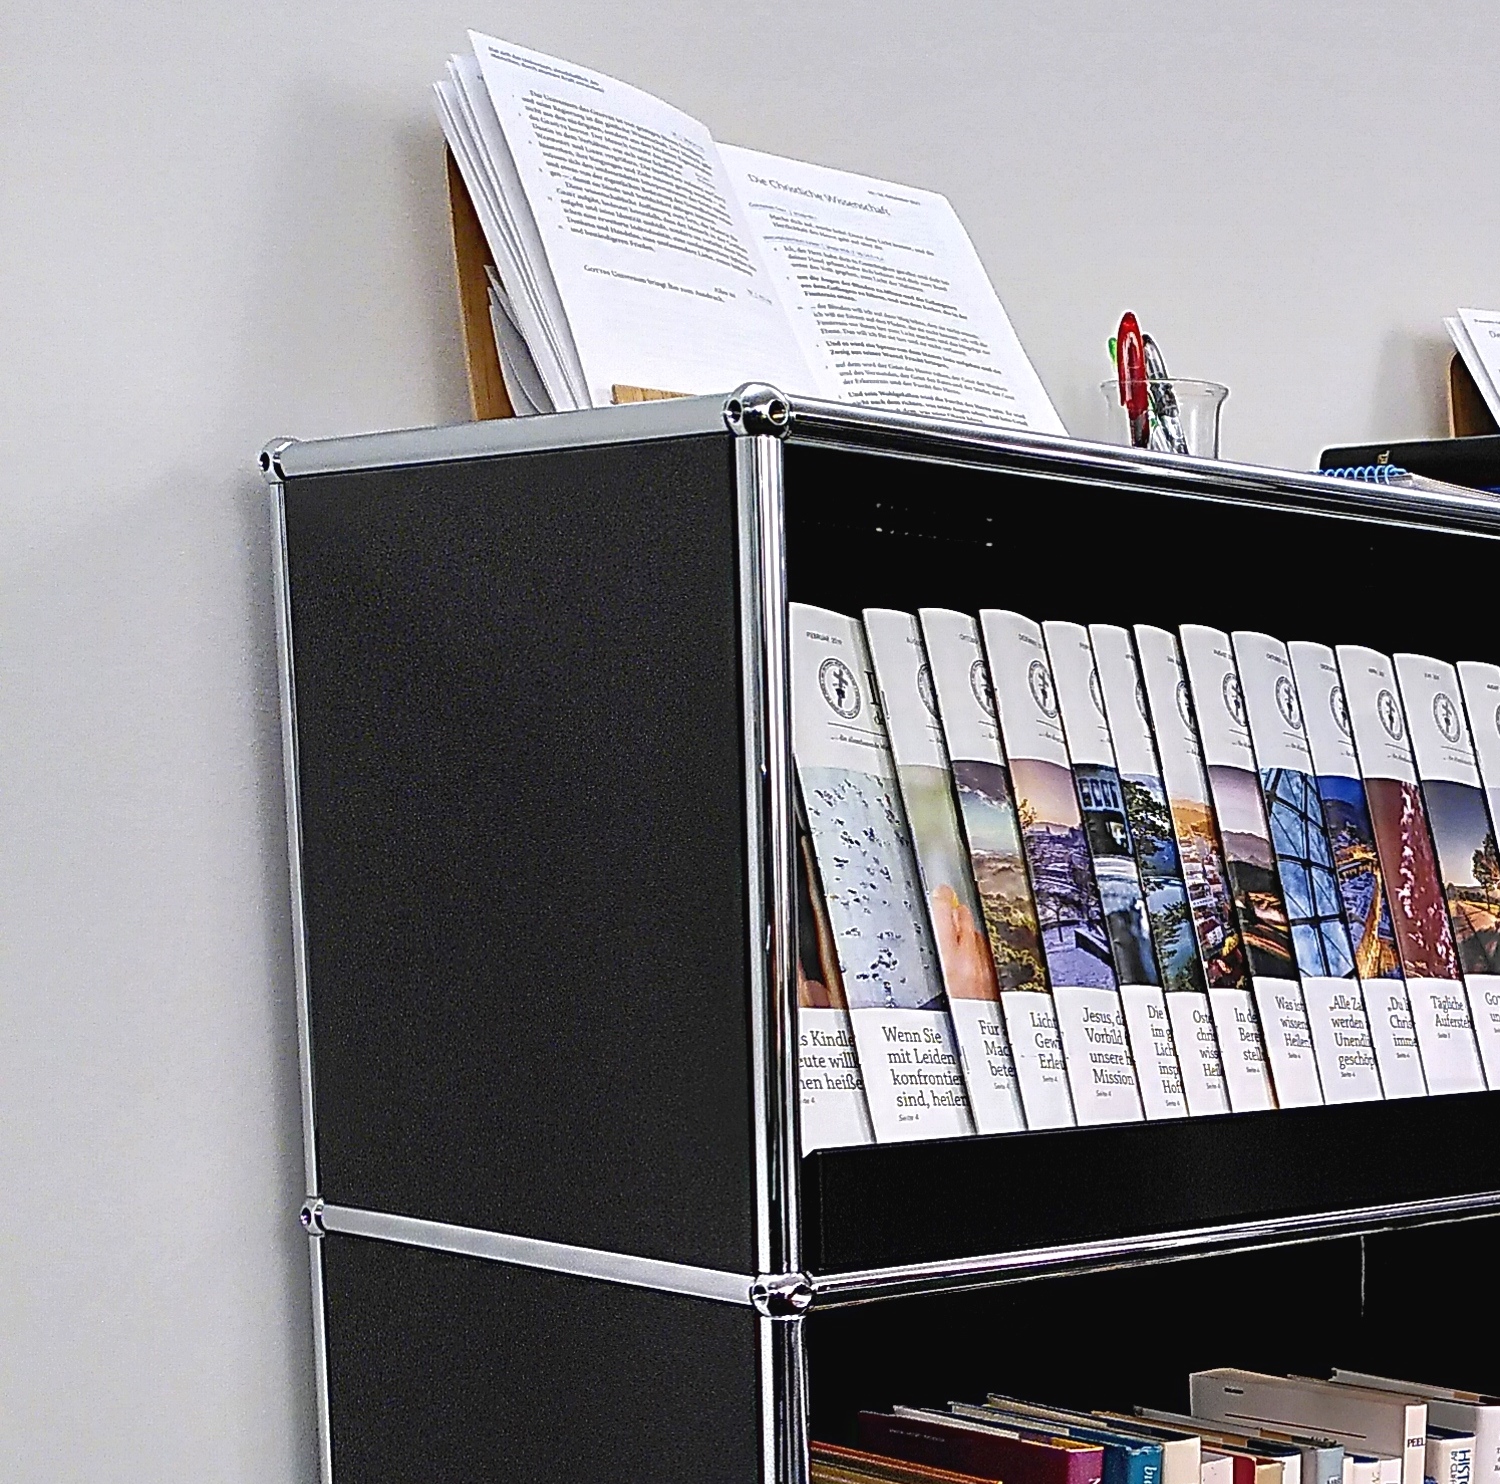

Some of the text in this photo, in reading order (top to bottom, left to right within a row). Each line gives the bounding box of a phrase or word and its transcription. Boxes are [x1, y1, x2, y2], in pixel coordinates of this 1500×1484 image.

[1083, 1007, 1114, 1026] Jesus,
[1147, 1005, 1163, 1019] Die
[882, 1026, 943, 1044] Wenn Sie
[978, 1020, 999, 1035] Für
[1085, 1028, 1123, 1045] Vorbild
[888, 1049, 956, 1065] mit Leiden
[1090, 1052, 1124, 1065] unsere
[1092, 1068, 1135, 1086] Mission
[897, 1092, 930, 1109] sind,
[1407, 1437, 1425, 1448] PEEL
